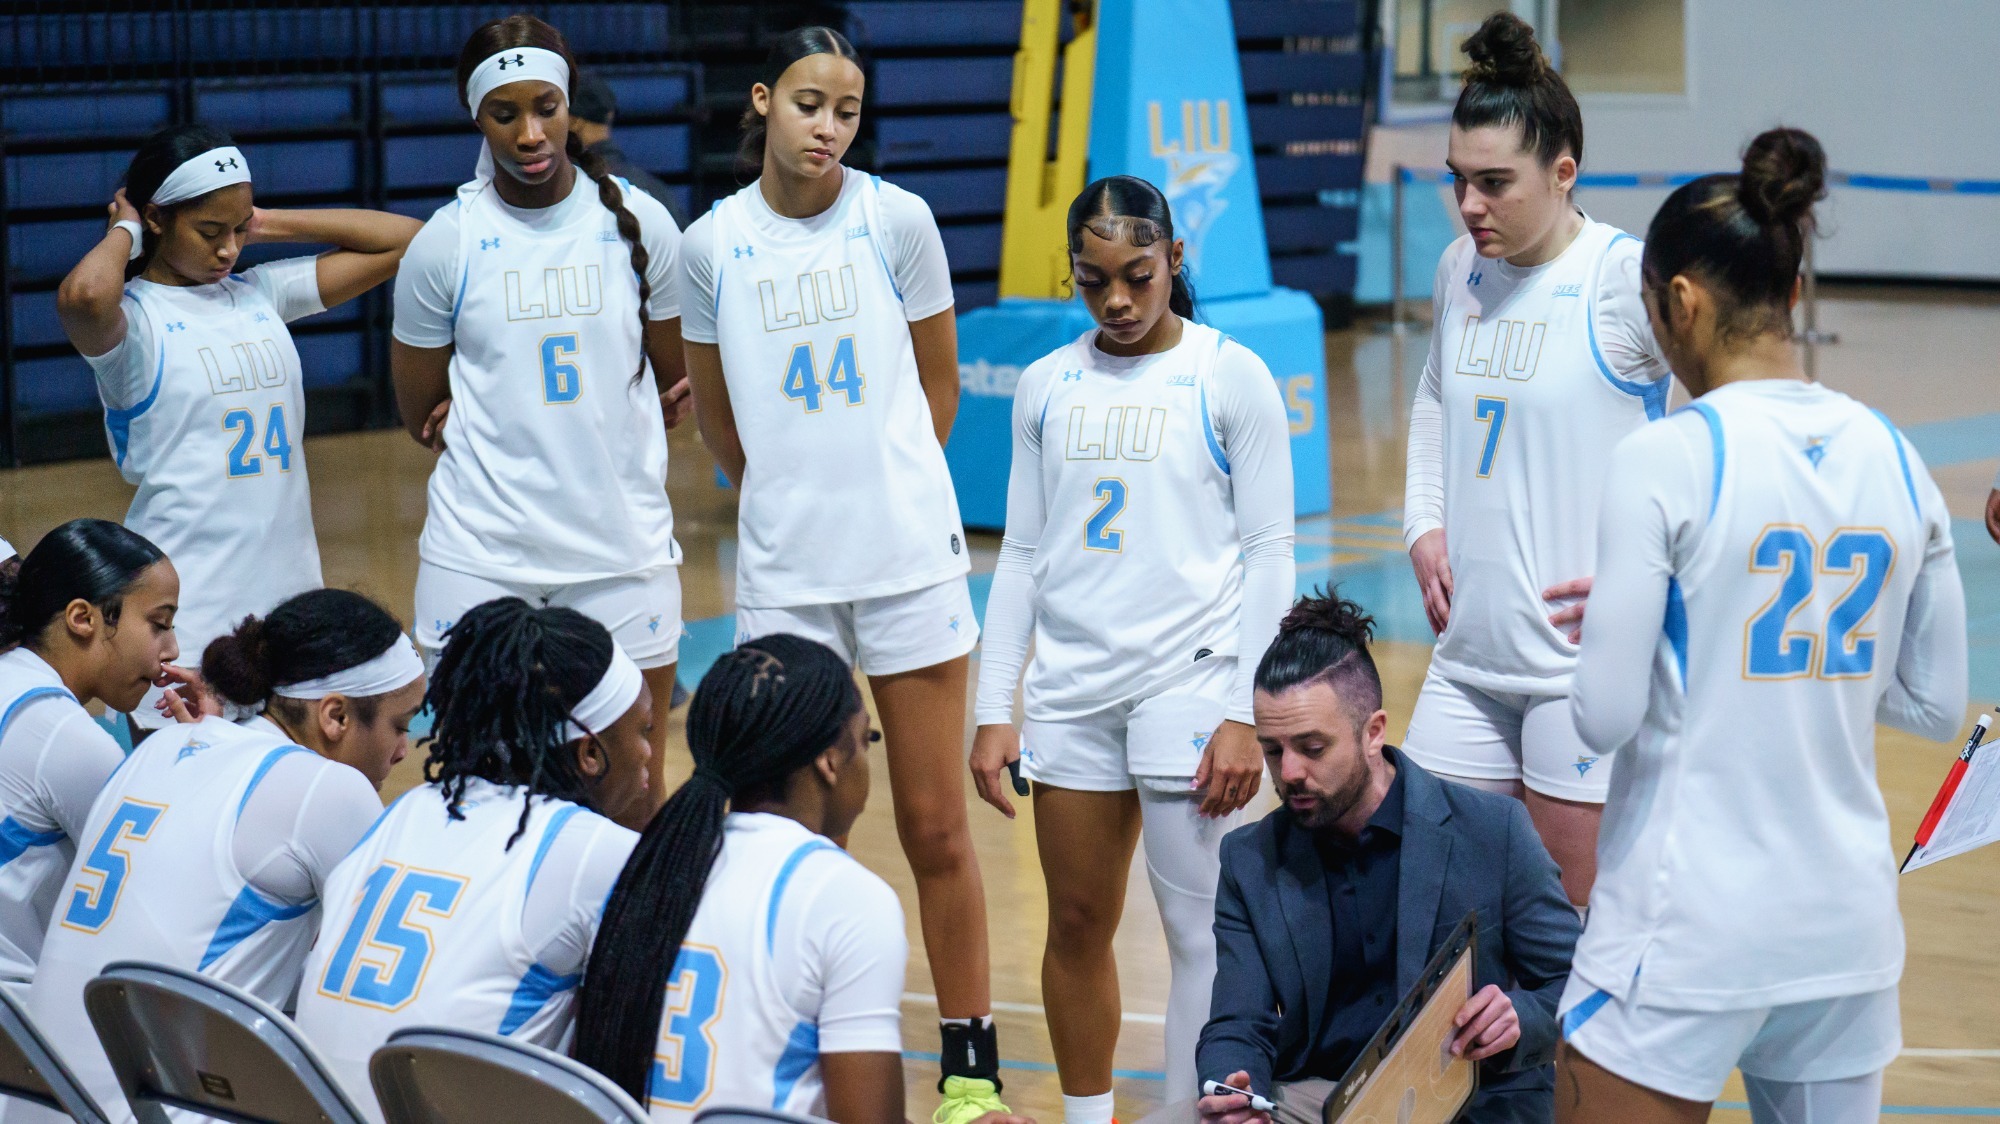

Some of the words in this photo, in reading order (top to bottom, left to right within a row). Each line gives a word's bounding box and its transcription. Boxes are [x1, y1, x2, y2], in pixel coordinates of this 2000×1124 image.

[1149, 101, 1230, 157] LIU
[504, 264, 603, 322] LIU
[758, 264, 859, 332] LIU
[1553, 284, 1582, 296] NEC
[198, 339, 287, 395] LIU
[538, 332, 583, 405] 6
[780, 334, 866, 414] 44
[1167, 375, 1196, 385] NEC
[1456, 315, 1547, 381] LIU
[221, 402, 292, 479] 24
[1066, 406, 1166, 461] LIU
[1474, 395, 1508, 479] 7
[1083, 476, 1128, 553] 2
[1742, 523, 1898, 681] 22
[61, 796, 169, 935] 5
[317, 859, 471, 1014] 15
[645, 940, 730, 1111] 3
